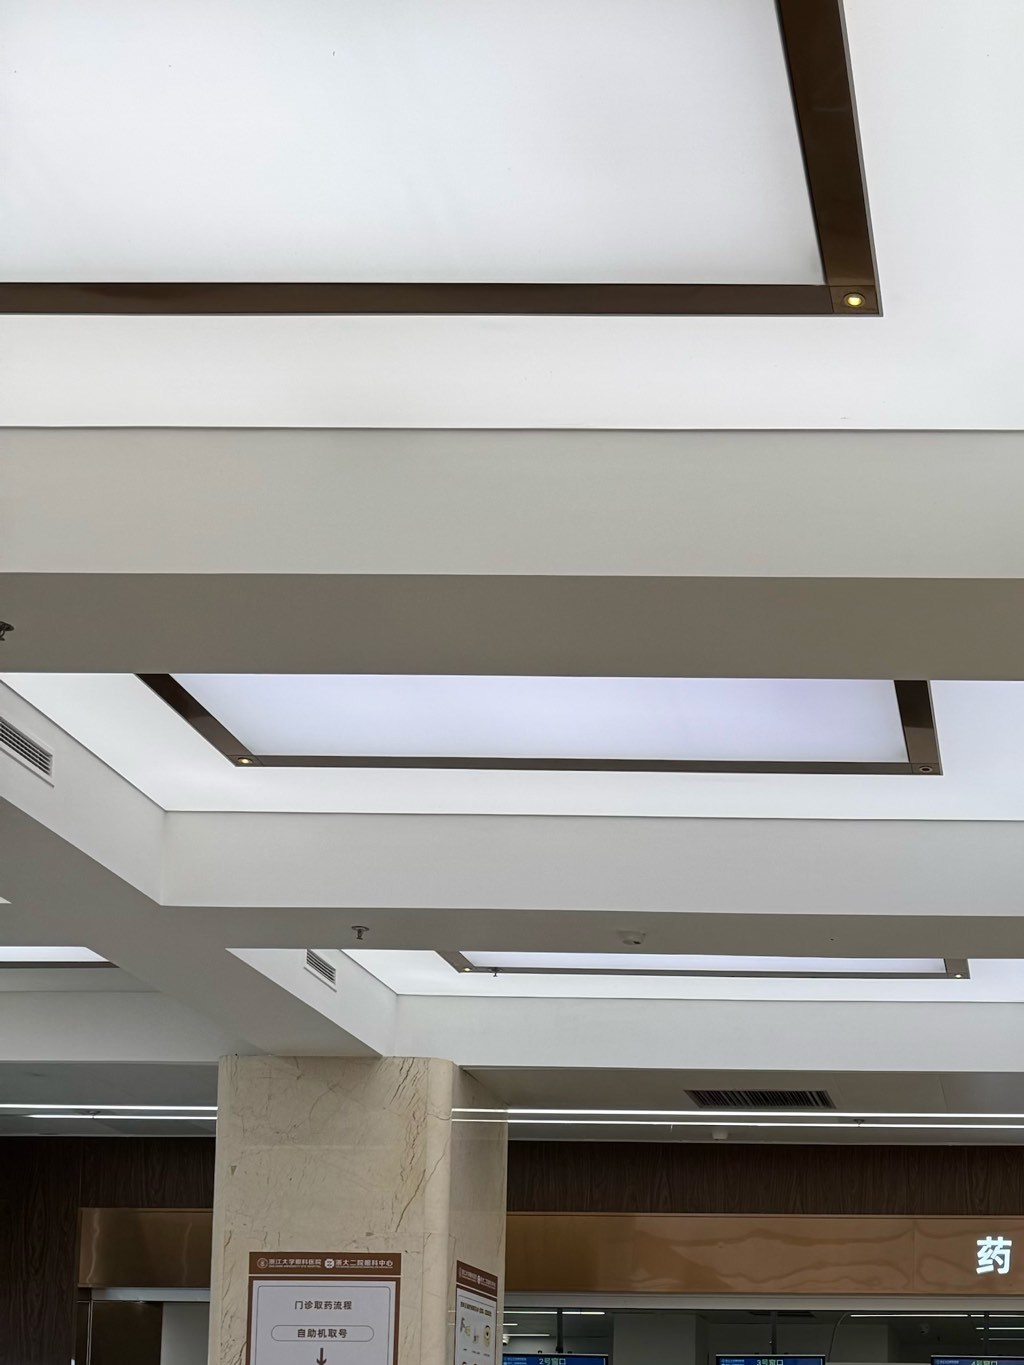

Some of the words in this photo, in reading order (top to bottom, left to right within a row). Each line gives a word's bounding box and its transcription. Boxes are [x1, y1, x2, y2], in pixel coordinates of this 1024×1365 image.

[294, 1300, 353, 1310] 门诊取药流程
[297, 1328, 348, 1339] 自助机取号
[538, 1358, 567, 1365] 2号窗口
